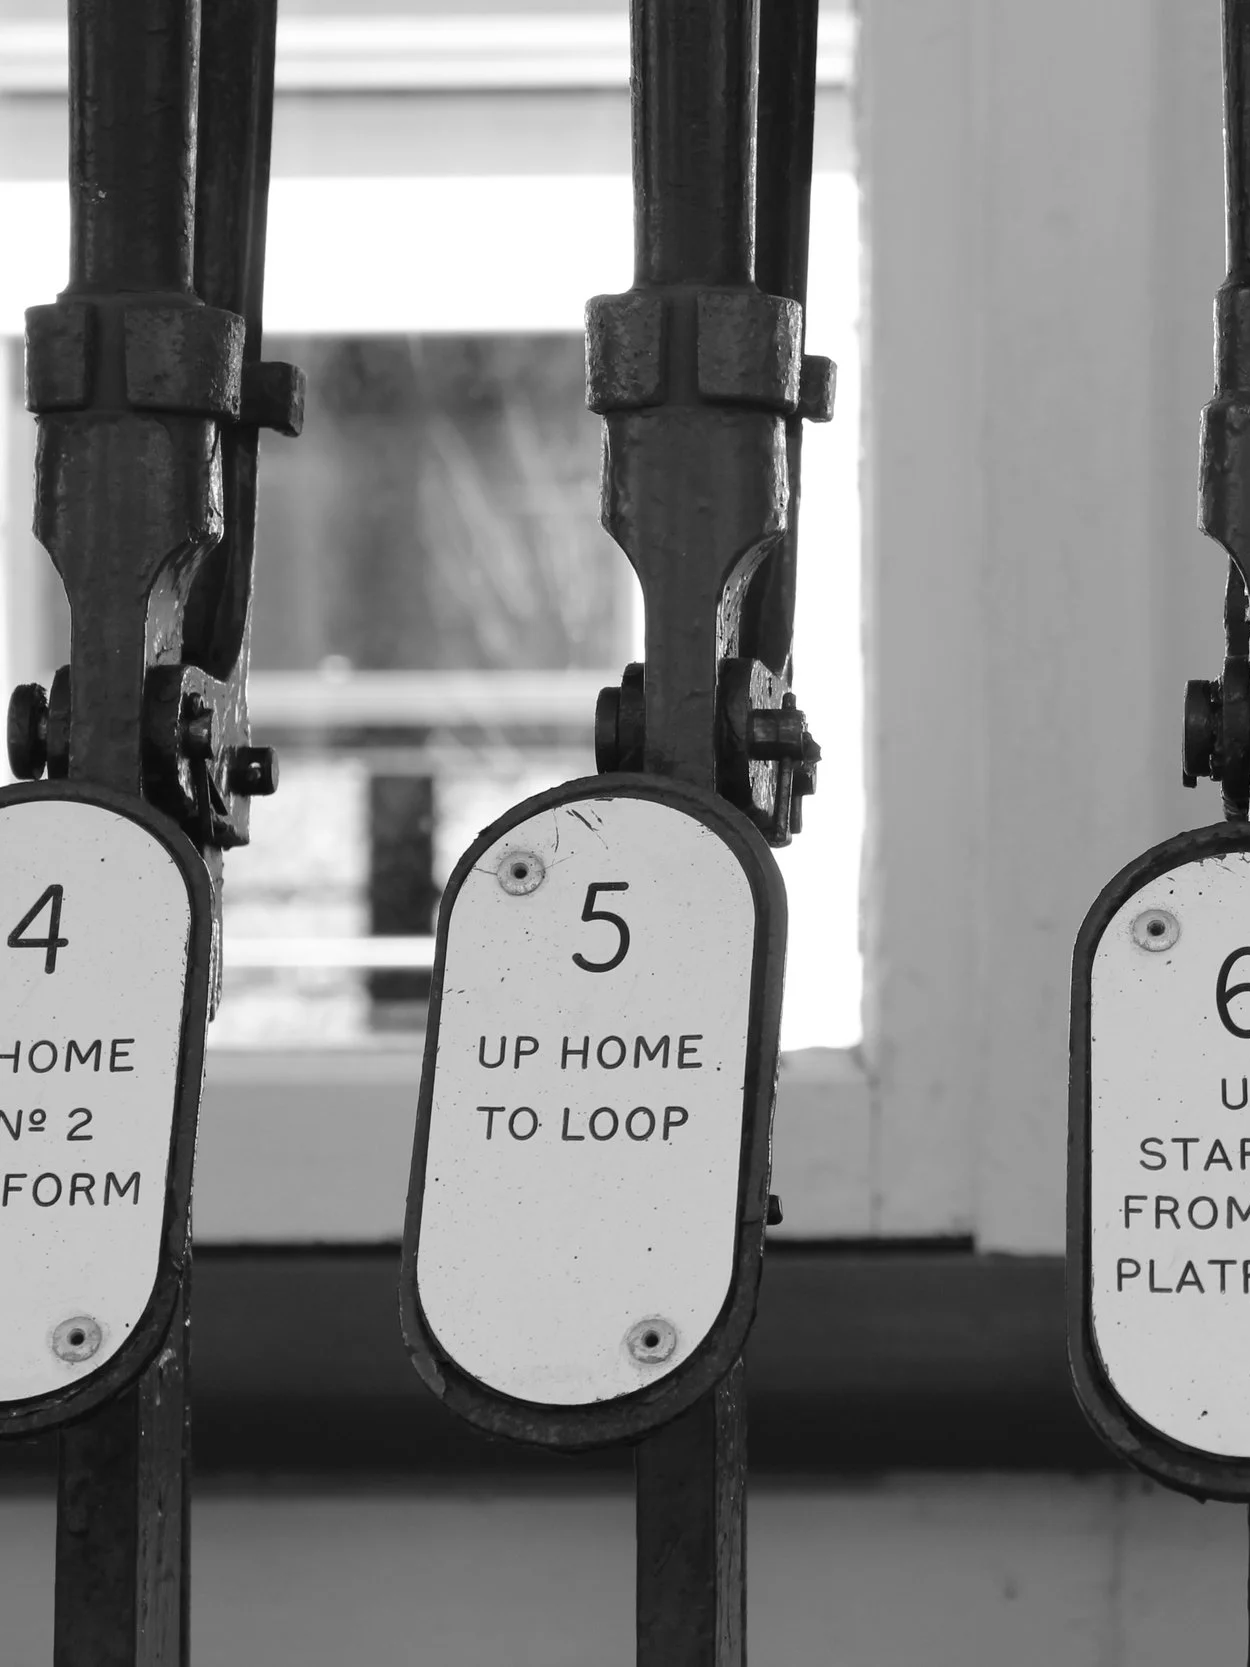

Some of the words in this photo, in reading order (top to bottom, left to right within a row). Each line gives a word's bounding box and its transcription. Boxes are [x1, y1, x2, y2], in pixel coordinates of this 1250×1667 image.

[6, 883, 69, 975] 4
[571, 881, 631, 973] 5
[0, 1038, 135, 1074] HOME
[478, 1035, 540, 1070] UP
[560, 1034, 704, 1070] HOME
[66, 1107, 93, 1142] 2
[476, 1106, 539, 1141] TO
[561, 1105, 689, 1142] LOOP
[2, 1171, 141, 1208] FORM
